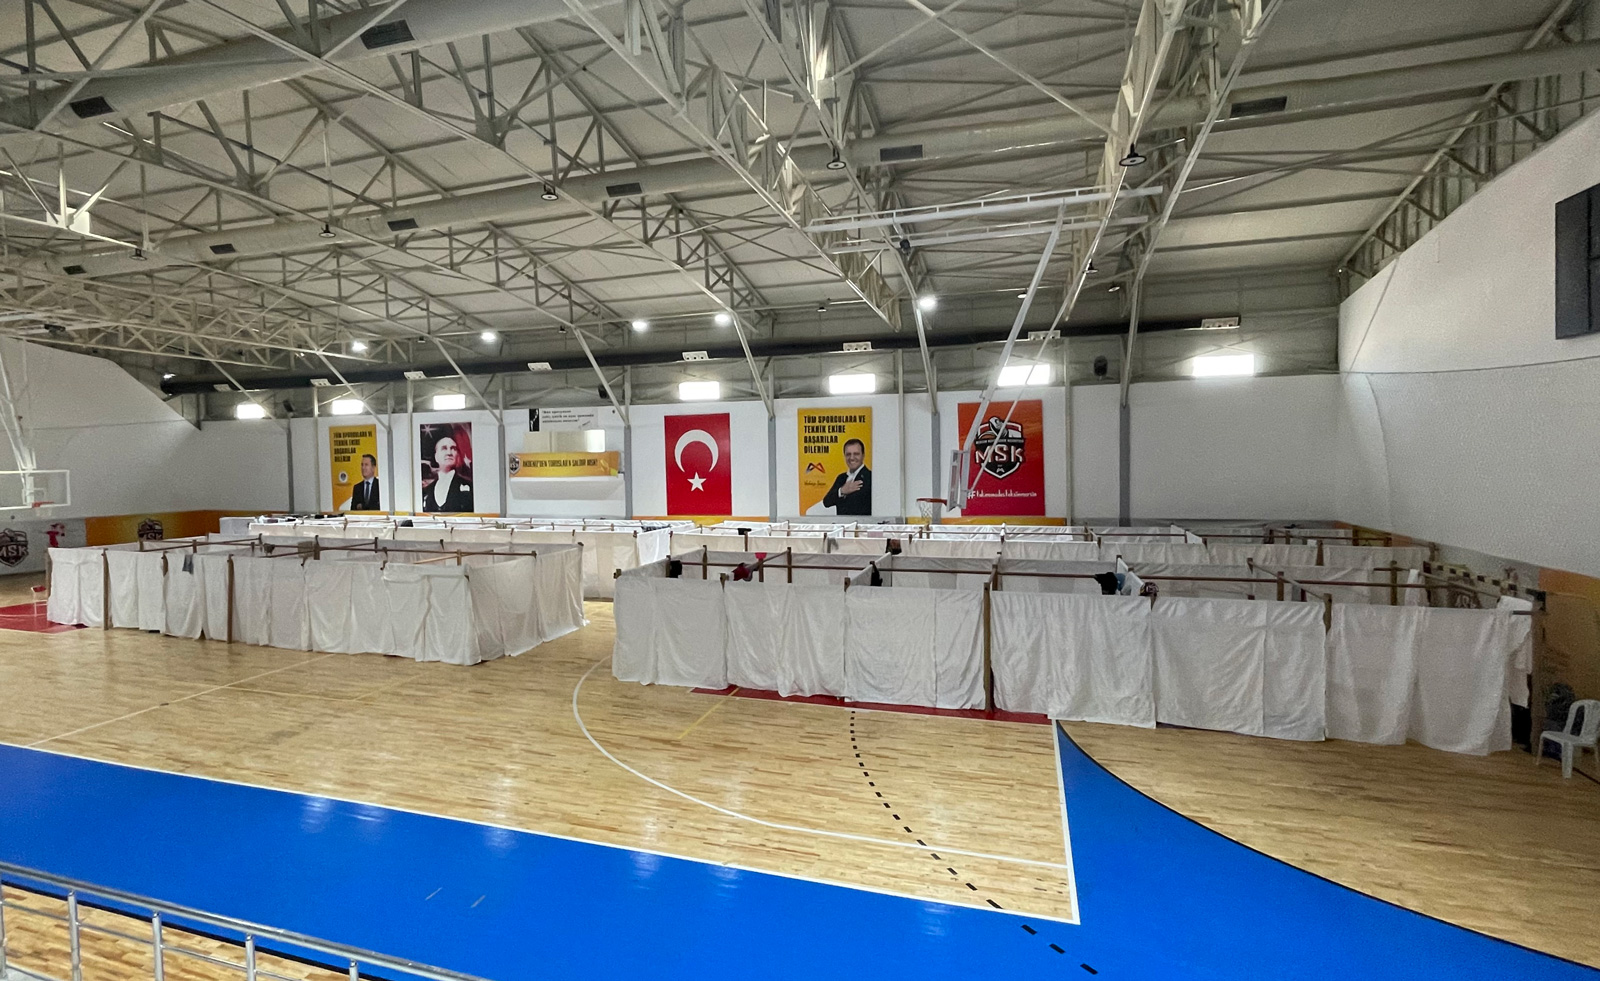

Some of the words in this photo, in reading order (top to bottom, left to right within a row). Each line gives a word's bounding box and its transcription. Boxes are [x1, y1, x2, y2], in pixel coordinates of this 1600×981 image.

[804, 415, 816, 423] TÜM
[818, 415, 857, 423] SPORCULARA
[859, 415, 866, 423] VE
[975, 444, 1023, 463] MSK
